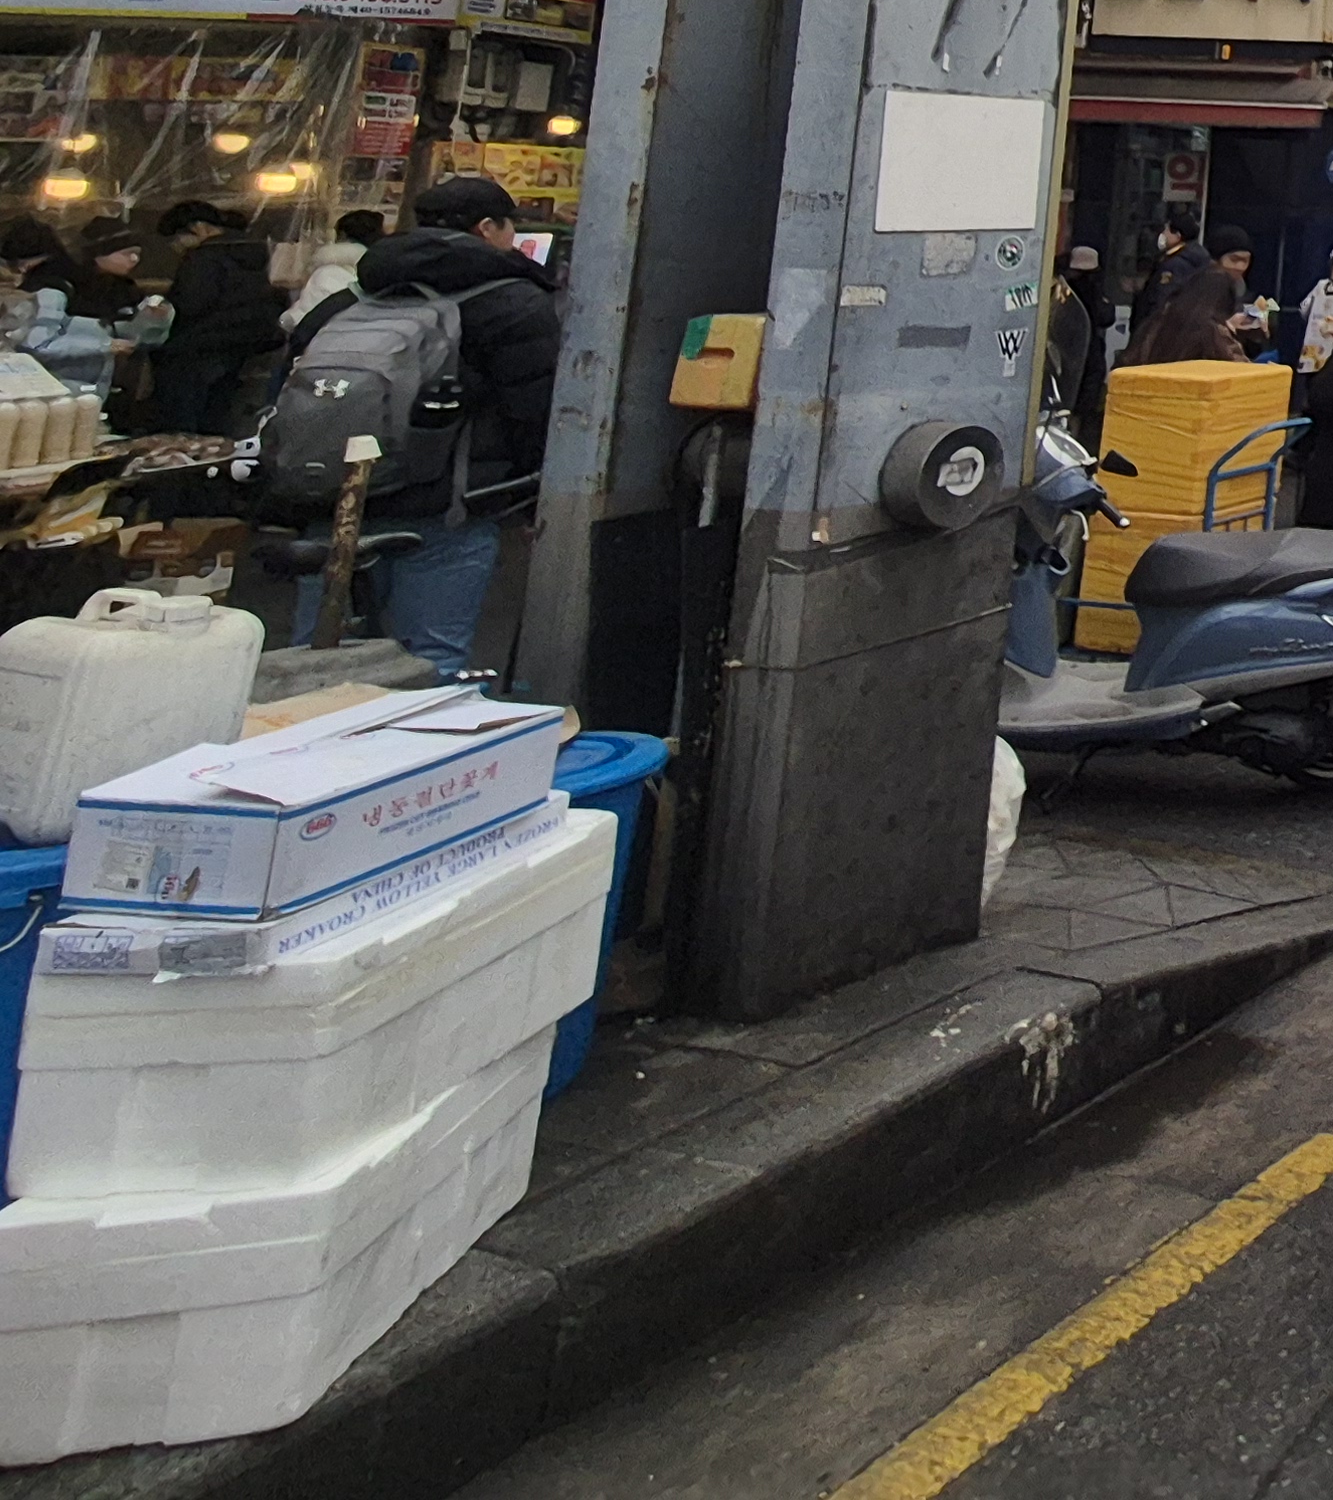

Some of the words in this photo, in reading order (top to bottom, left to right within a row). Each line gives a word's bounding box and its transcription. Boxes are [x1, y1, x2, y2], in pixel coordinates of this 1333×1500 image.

[410, 860, 432, 879] OF
[350, 871, 406, 904] CHINA
[375, 873, 441, 911] YELLOW
[278, 905, 366, 954] CROAKER
